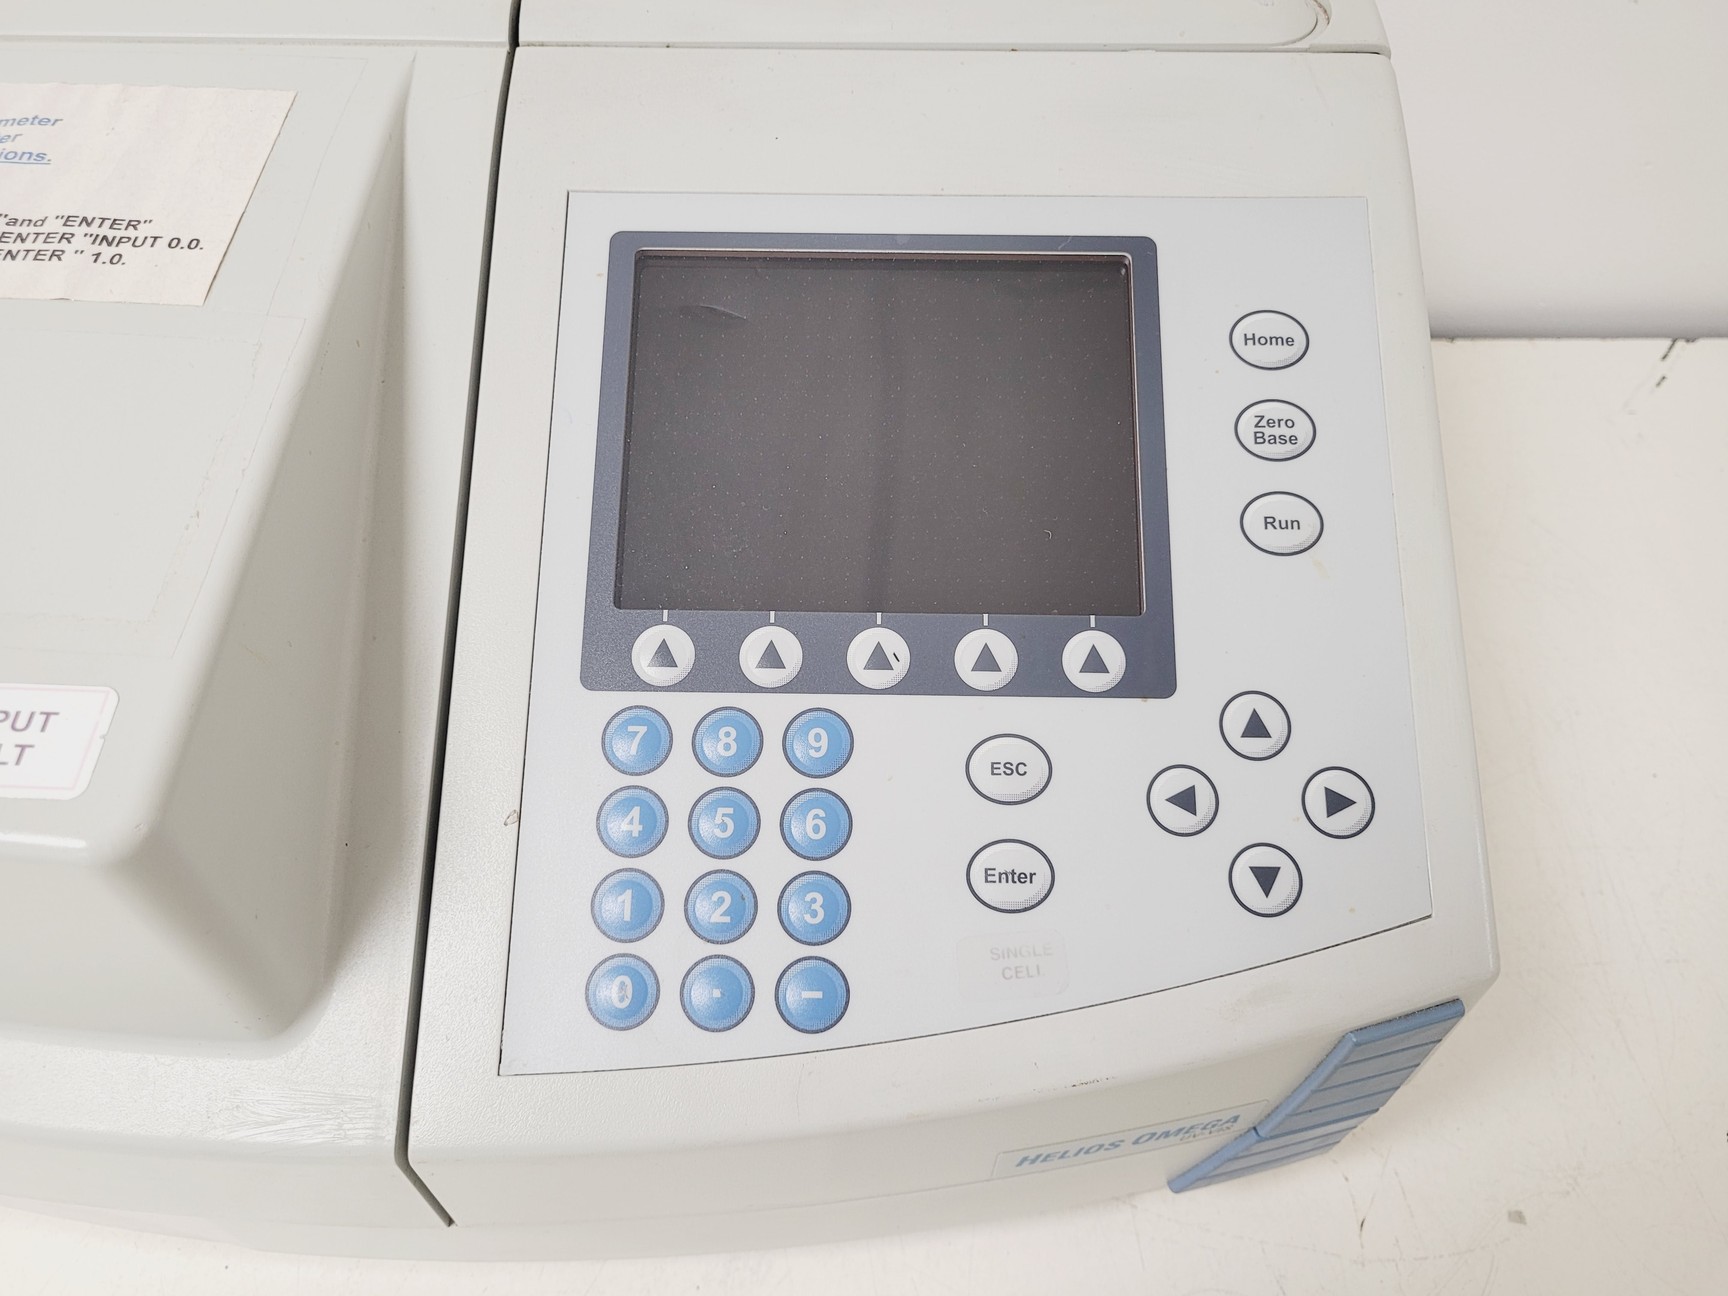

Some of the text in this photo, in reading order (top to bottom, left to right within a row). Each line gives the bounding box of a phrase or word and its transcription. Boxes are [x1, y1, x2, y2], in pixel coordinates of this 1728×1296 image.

[55, 215, 153, 231] "ENTER"
[0, 231, 204, 250] ENTER "INPUT 0.0.
[91, 252, 126, 265] 1.0.
[1243, 333, 1295, 346] Home
[1254, 415, 1295, 429] Zero
[1253, 431, 1298, 445] Base
[1263, 516, 1301, 530] Run
[627, 725, 829, 758] 7 8 9
[990, 761, 1028, 776] ESC
[621, 806, 827, 840] 4 5 6
[983, 867, 1037, 884] Enter
[617, 888, 825, 924] 1 2 3
[989, 942, 1054, 961] SINGLE
[610, 975, 633, 1009] 0
[1015, 1139, 1126, 1168] HELIOS
[1131, 1114, 1241, 1145] OMEGA
